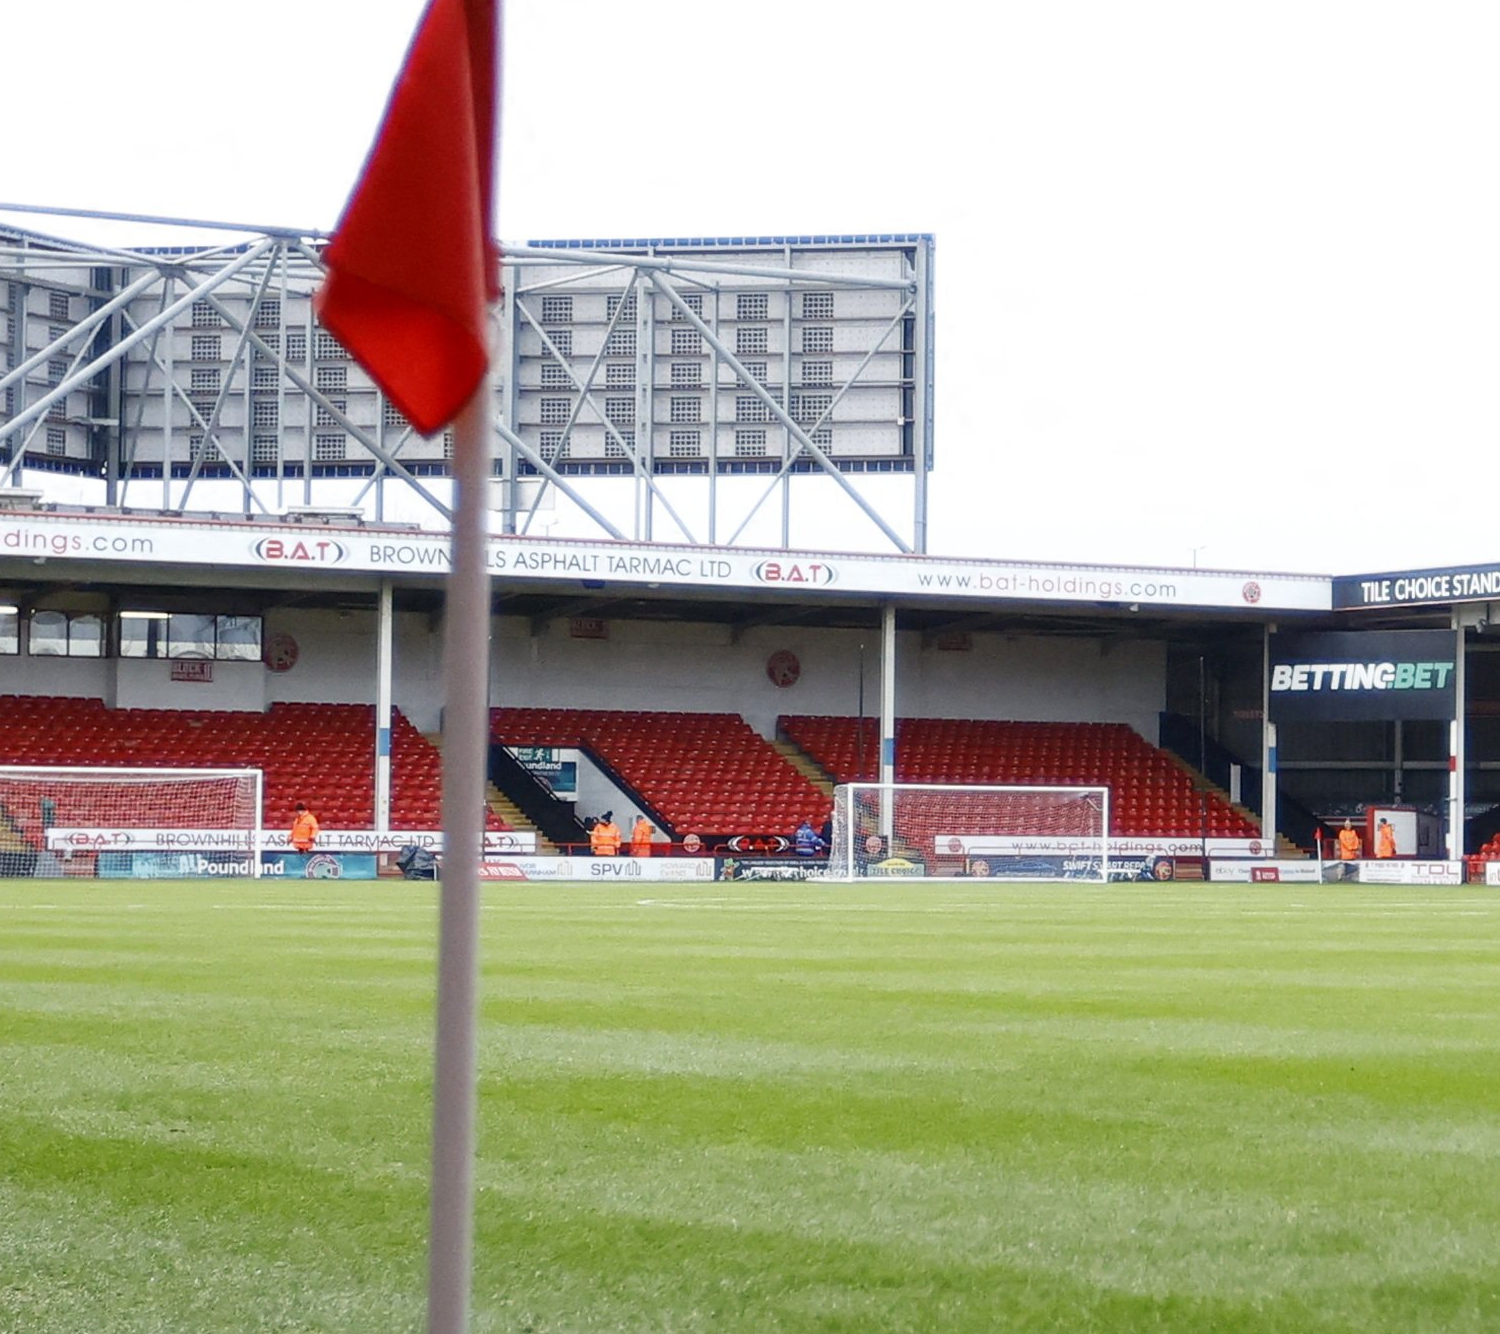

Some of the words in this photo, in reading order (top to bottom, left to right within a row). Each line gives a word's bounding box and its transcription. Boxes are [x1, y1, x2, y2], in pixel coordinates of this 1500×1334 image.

[266, 539, 331, 561] B.A.T
[370, 545, 506, 568] BROWNLS
[513, 552, 599, 573] ASPHALT
[607, 556, 692, 576] TARMAC
[700, 560, 732, 578] LTD
[765, 563, 822, 583] B.A.T
[918, 572, 1176, 599] www.bat-holdings.com
[1361, 580, 1390, 603] TILE
[1394, 575, 1450, 600] CHOICE
[523, 761, 562, 770] undland
[338, 834, 403, 847] TARMAC
[198, 858, 284, 875] Poundlnd
[591, 863, 624, 876] SPV
